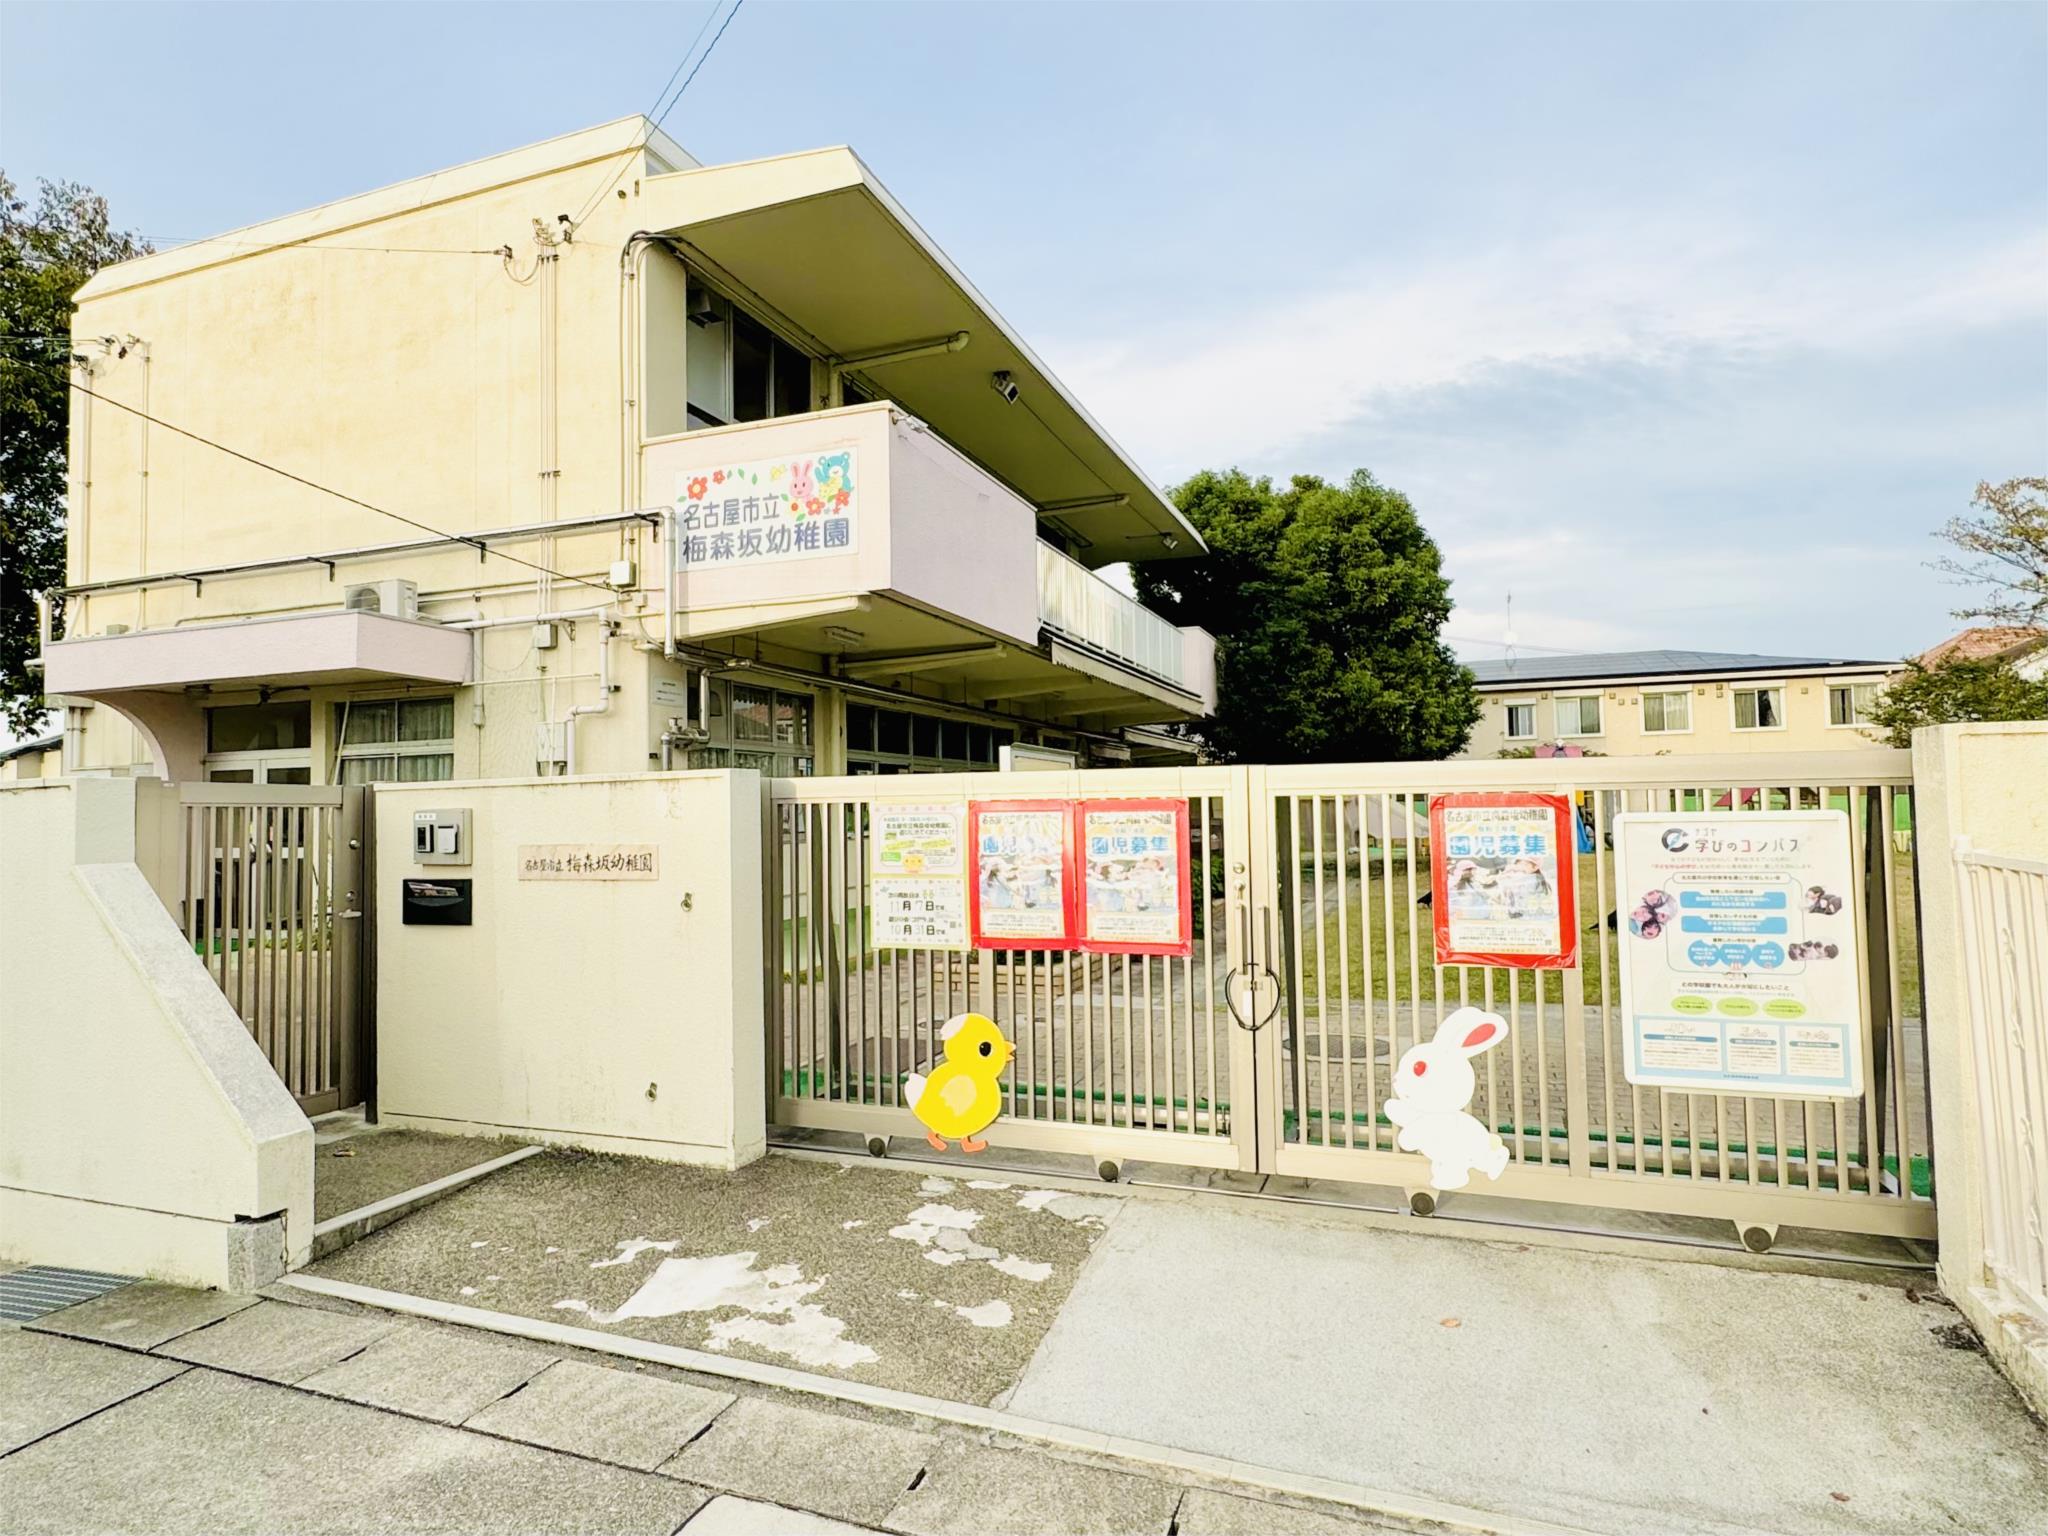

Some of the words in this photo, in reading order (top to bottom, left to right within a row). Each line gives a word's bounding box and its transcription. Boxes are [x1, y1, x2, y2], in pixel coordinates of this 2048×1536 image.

[683, 493, 780, 531] 名古屋市立
[682, 517, 850, 564] 梅森坂幼稚園
[1091, 836, 1169, 854] 園児募集
[1449, 834, 1546, 855] 園児募集
